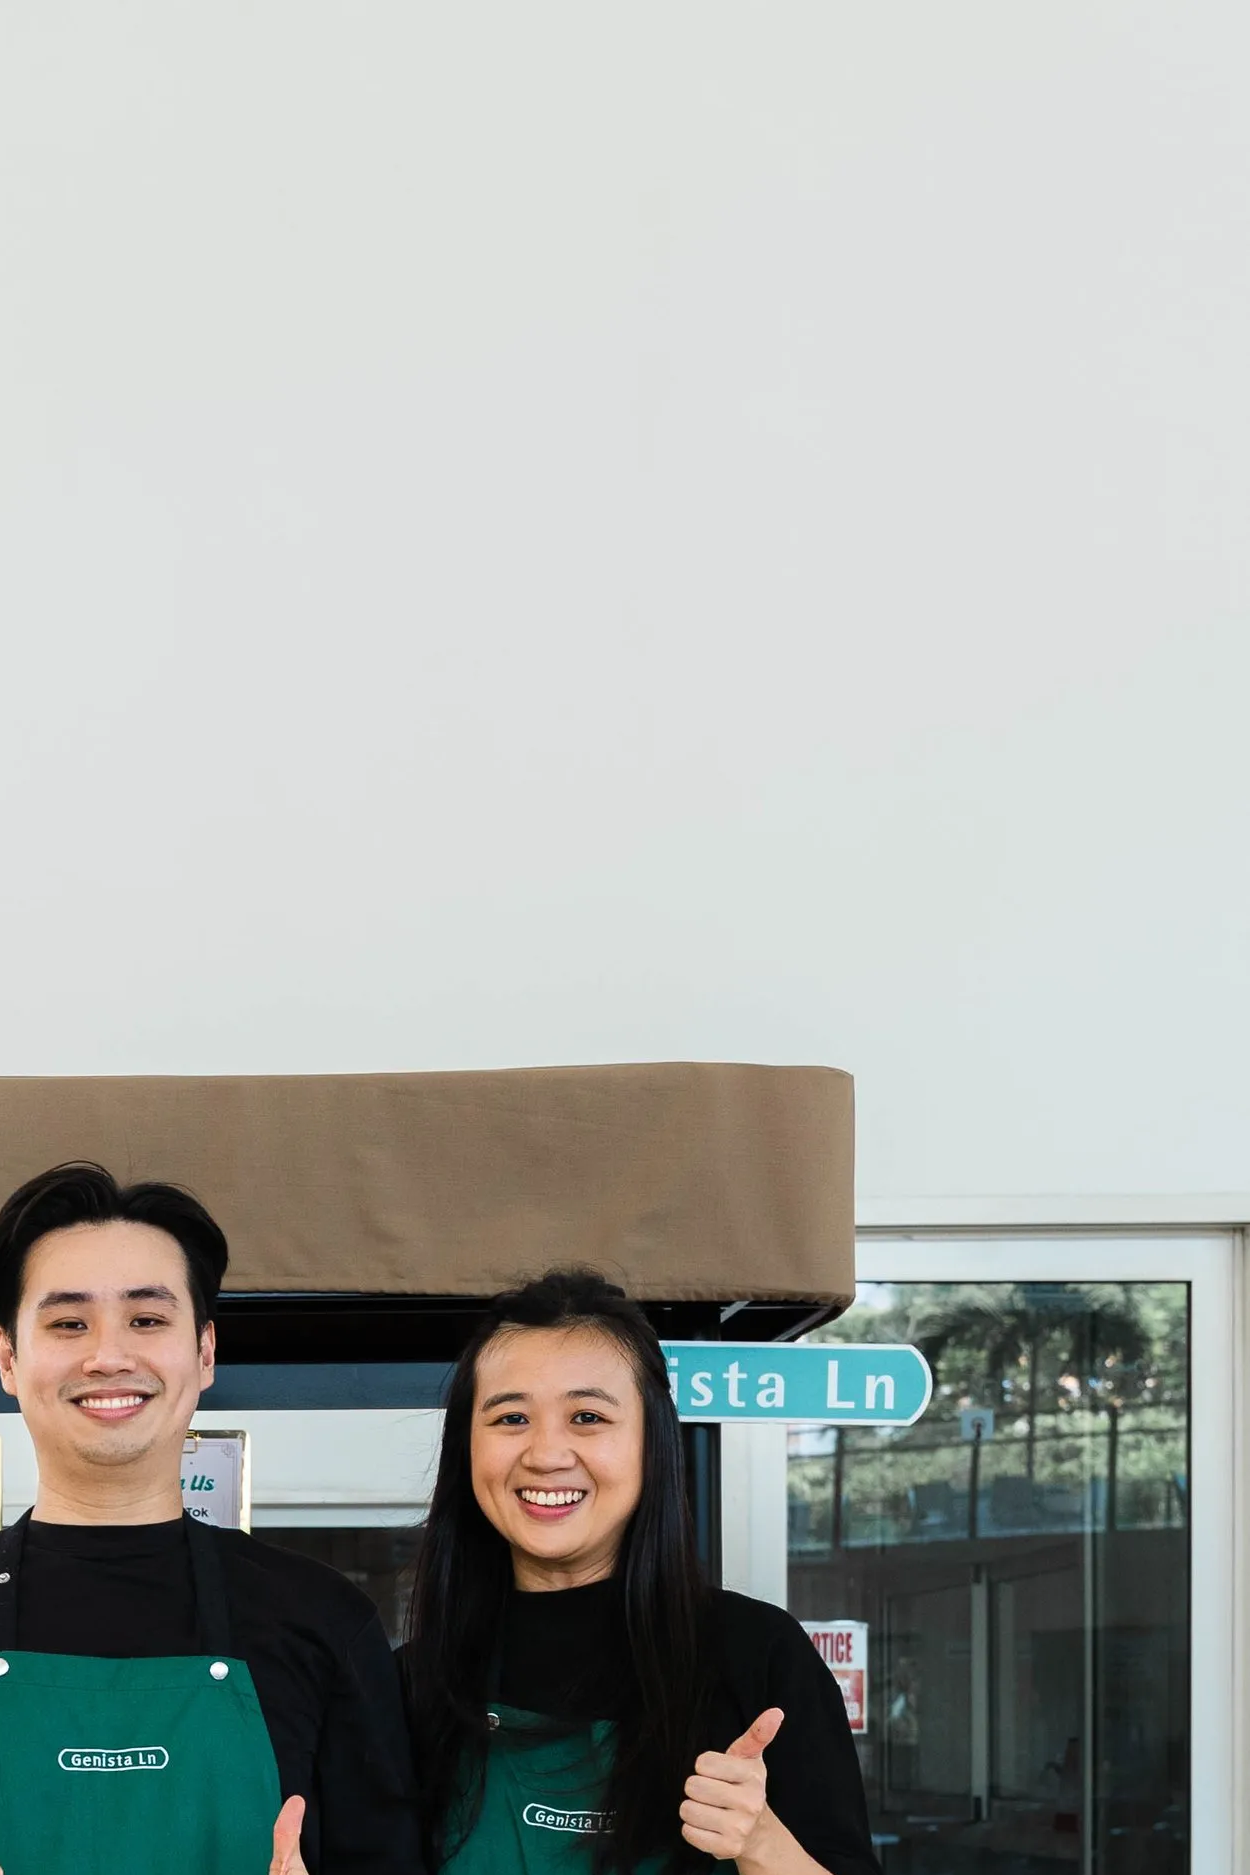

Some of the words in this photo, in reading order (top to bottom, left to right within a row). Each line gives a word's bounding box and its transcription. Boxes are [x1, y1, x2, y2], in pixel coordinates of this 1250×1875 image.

[826, 1359, 895, 1410] Ln
[190, 1475, 215, 1491] Us
[810, 1632, 853, 1664] OTICE
[71, 1753, 132, 1767] Genista
[139, 1752, 156, 1765] Ln
[535, 1810, 592, 1829] Genista
